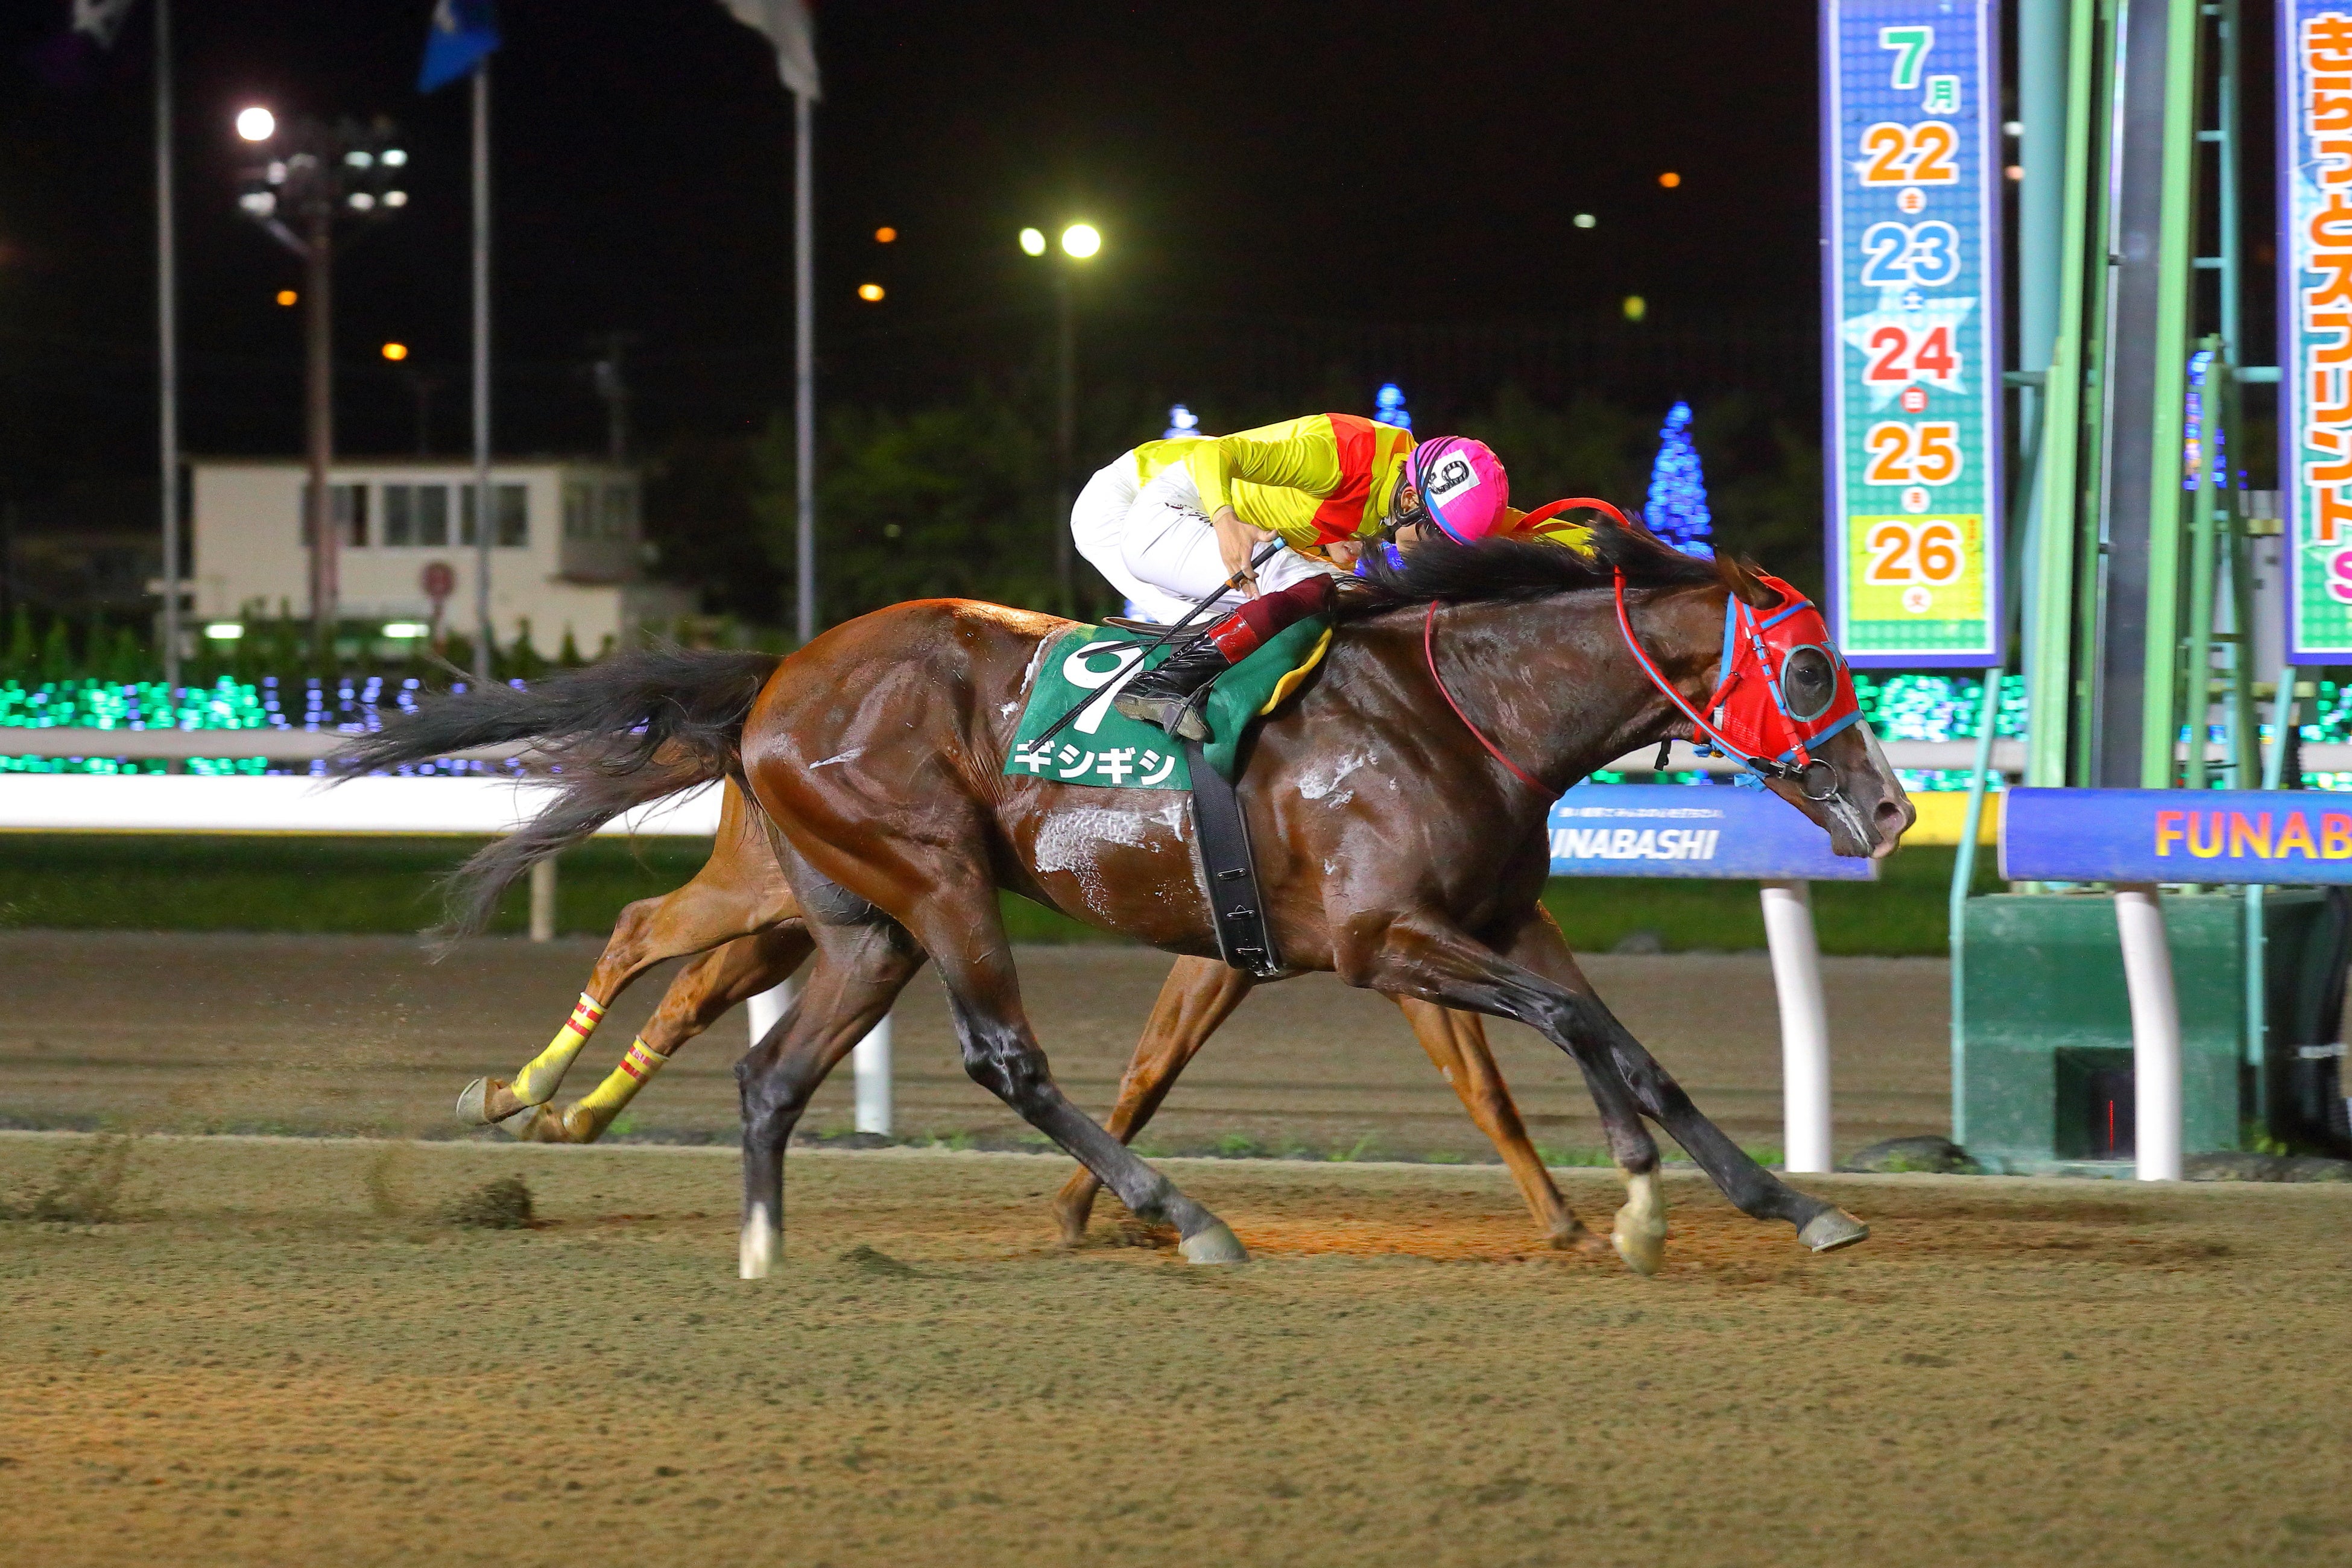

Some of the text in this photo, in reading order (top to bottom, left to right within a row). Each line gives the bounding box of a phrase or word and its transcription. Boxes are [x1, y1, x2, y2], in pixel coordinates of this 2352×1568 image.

[1866, 125, 1954, 182] 22
[1867, 225, 1954, 282] 23
[1869, 326, 1955, 381] 24
[1427, 460, 1470, 495] 9
[1870, 425, 1958, 482] 25
[1872, 525, 1959, 581] 26
[1063, 640, 1146, 735] 9
[1013, 738, 1176, 785] ギシギシ
[2155, 811, 2352, 859] FUNAB
